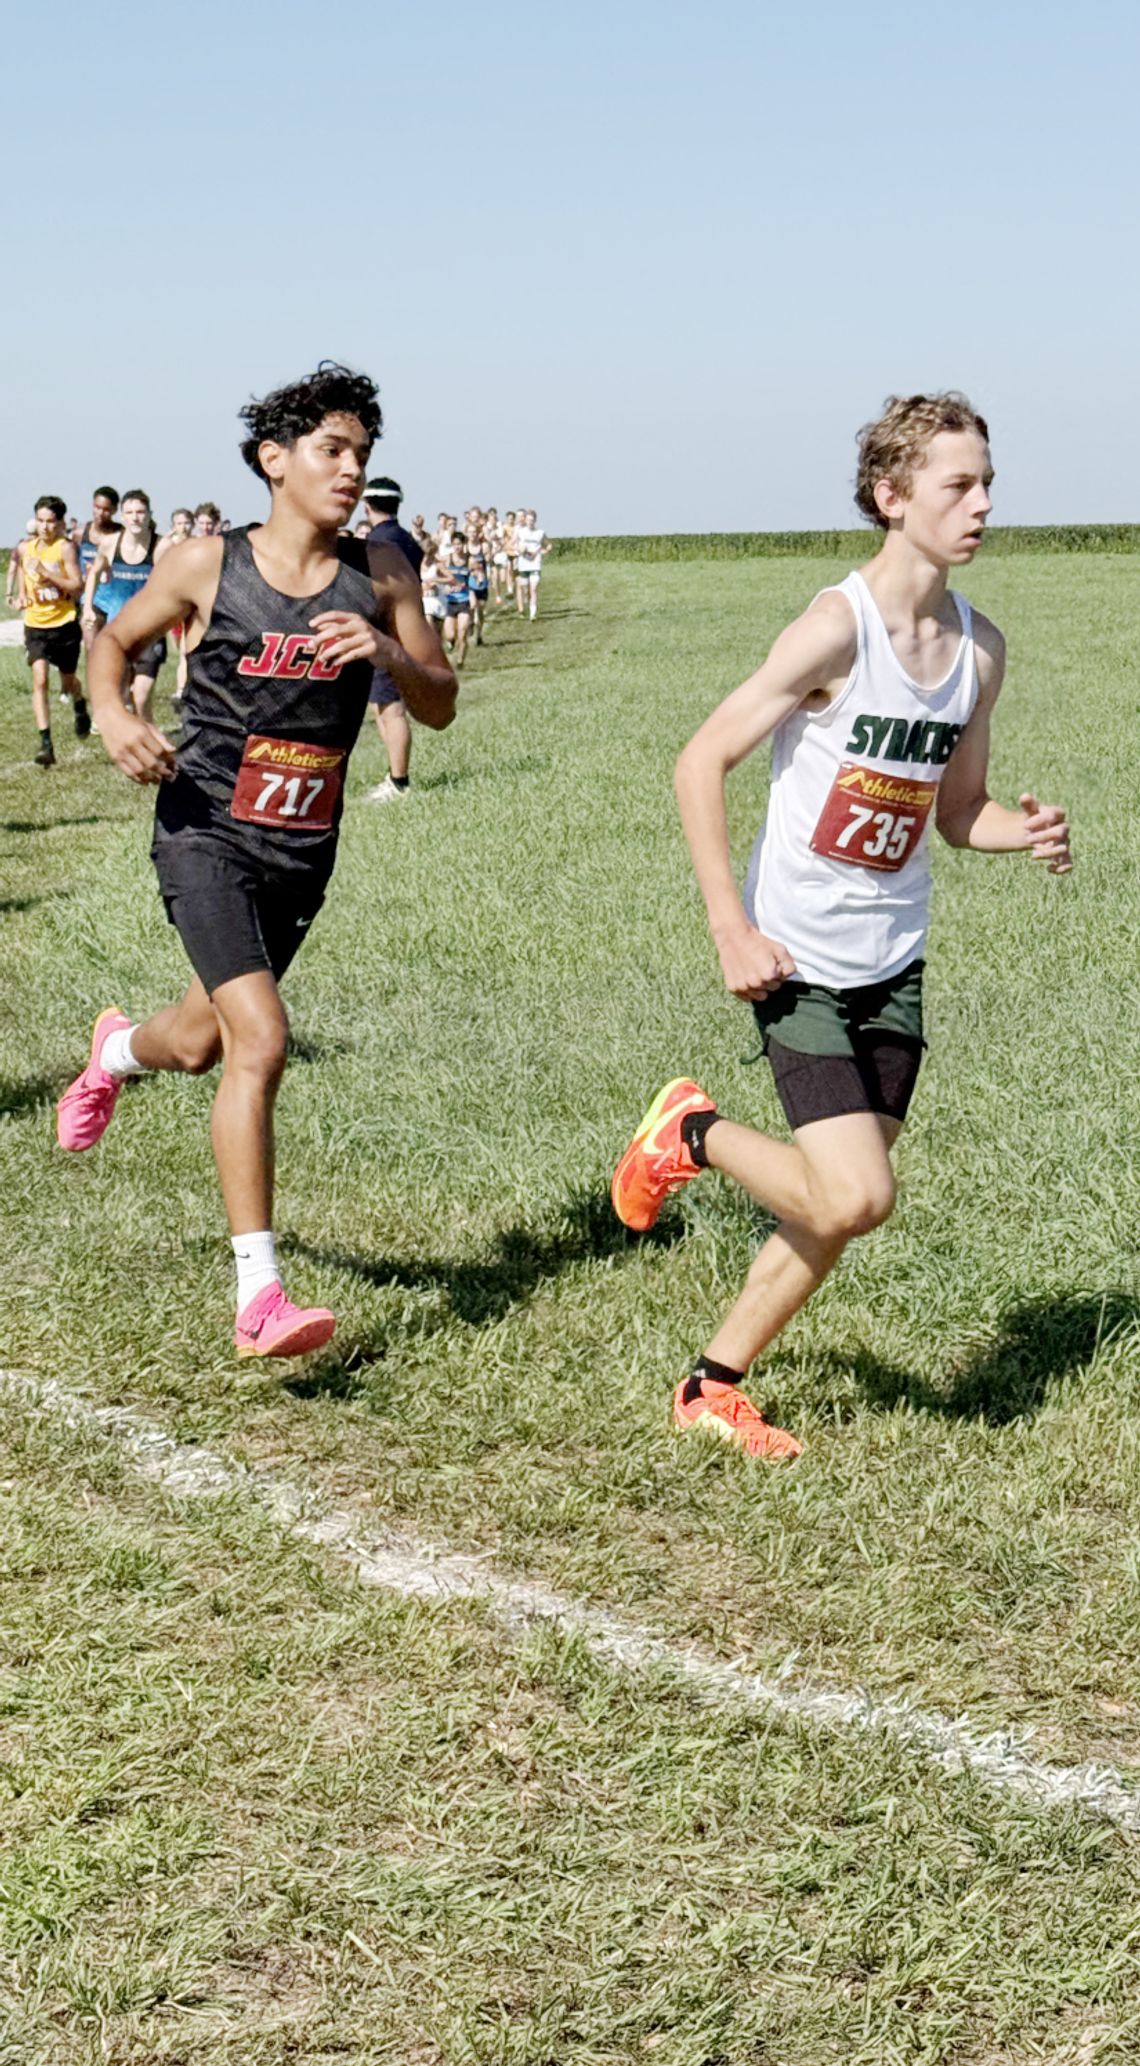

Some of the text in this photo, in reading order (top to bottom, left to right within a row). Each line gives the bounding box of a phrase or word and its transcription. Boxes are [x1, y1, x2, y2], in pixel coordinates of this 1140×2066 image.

[845, 714, 964, 765] SYRACUS
[254, 773, 324, 816] 717
[835, 804, 916, 860] 735
